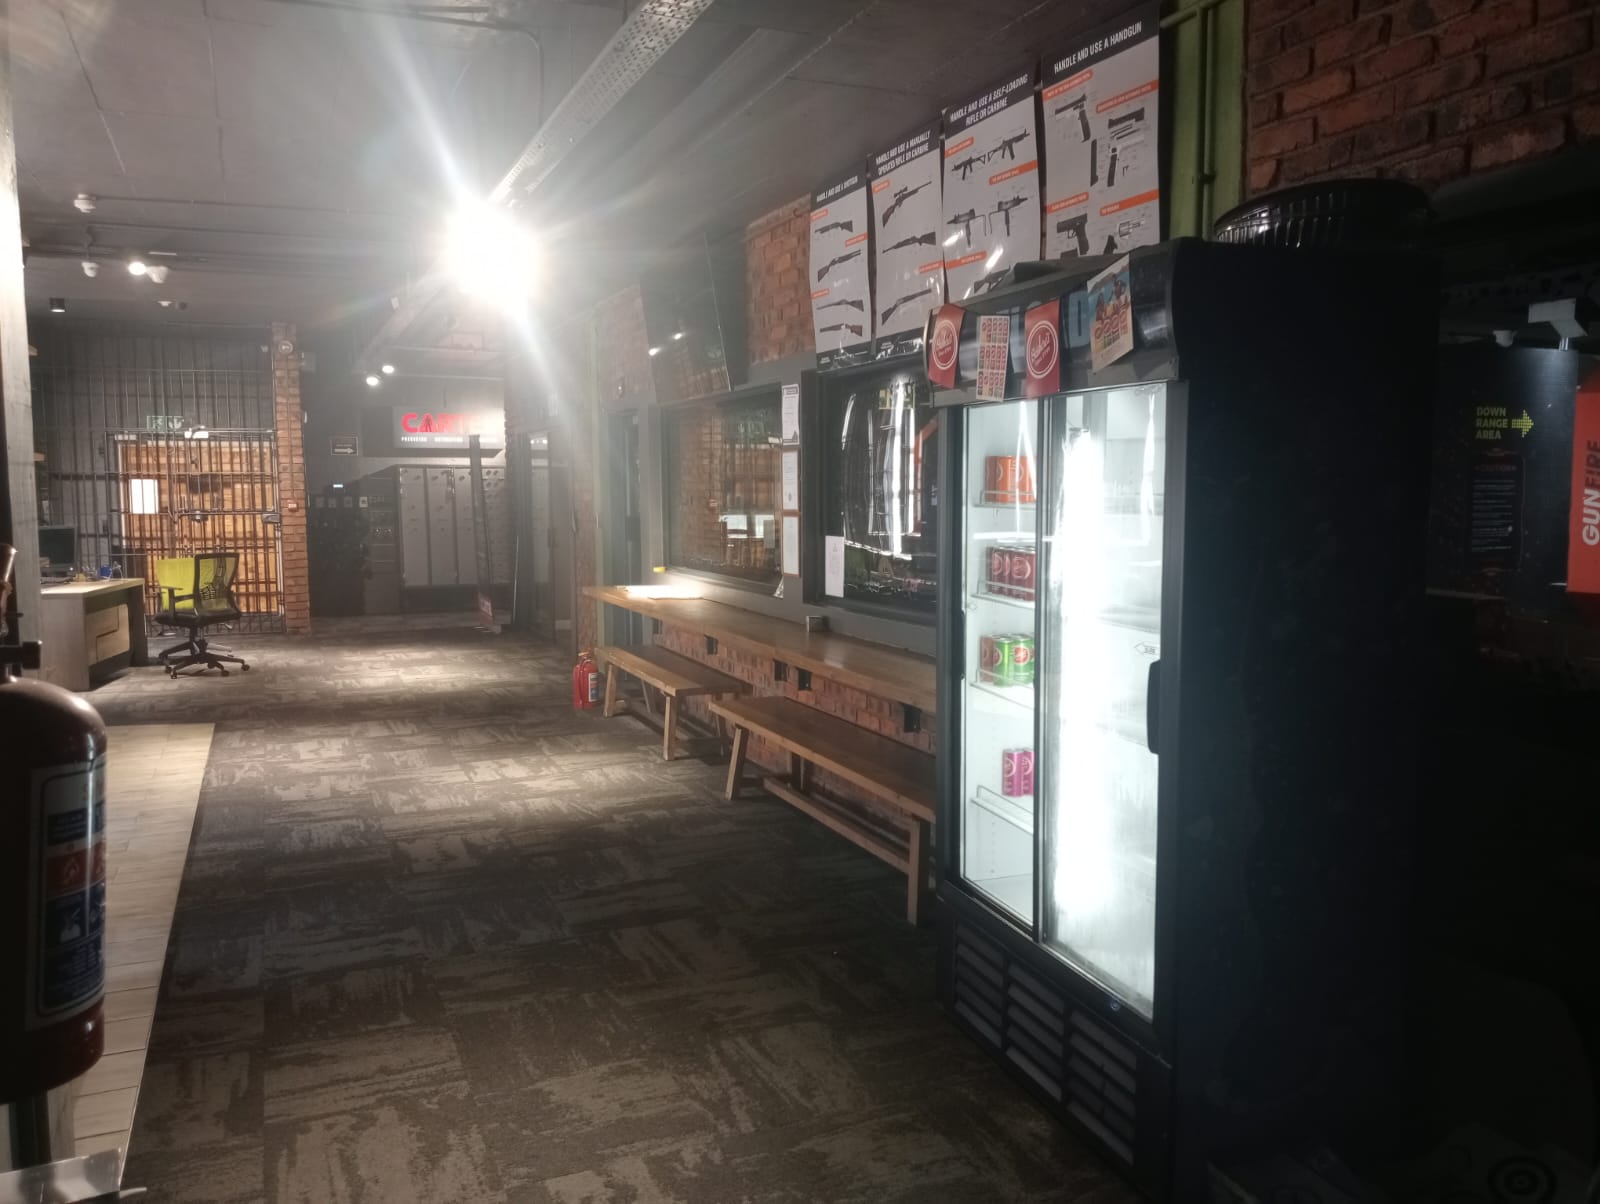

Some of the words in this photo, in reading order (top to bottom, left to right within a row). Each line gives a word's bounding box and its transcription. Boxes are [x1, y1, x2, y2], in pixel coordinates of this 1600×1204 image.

[1054, 53, 1076, 74] HANDLE
[1077, 47, 1089, 63] AND
[1089, 40, 1103, 55] USE
[1104, 37, 1109, 49] A
[1110, 21, 1142, 46] HANDGUN
[950, 106, 967, 123] HANDLE
[967, 100, 978, 114] AND
[978, 95, 988, 108] USE
[993, 73, 1028, 100] SELF-LOADING
[965, 112, 979, 127] RIFLE
[980, 108, 987, 119] OR
[987, 96, 1008, 116] CARBINE
[1476, 407, 1507, 417] DOWN
[1476, 418, 1508, 429] RANGE
[1476, 430, 1502, 440] AREA
